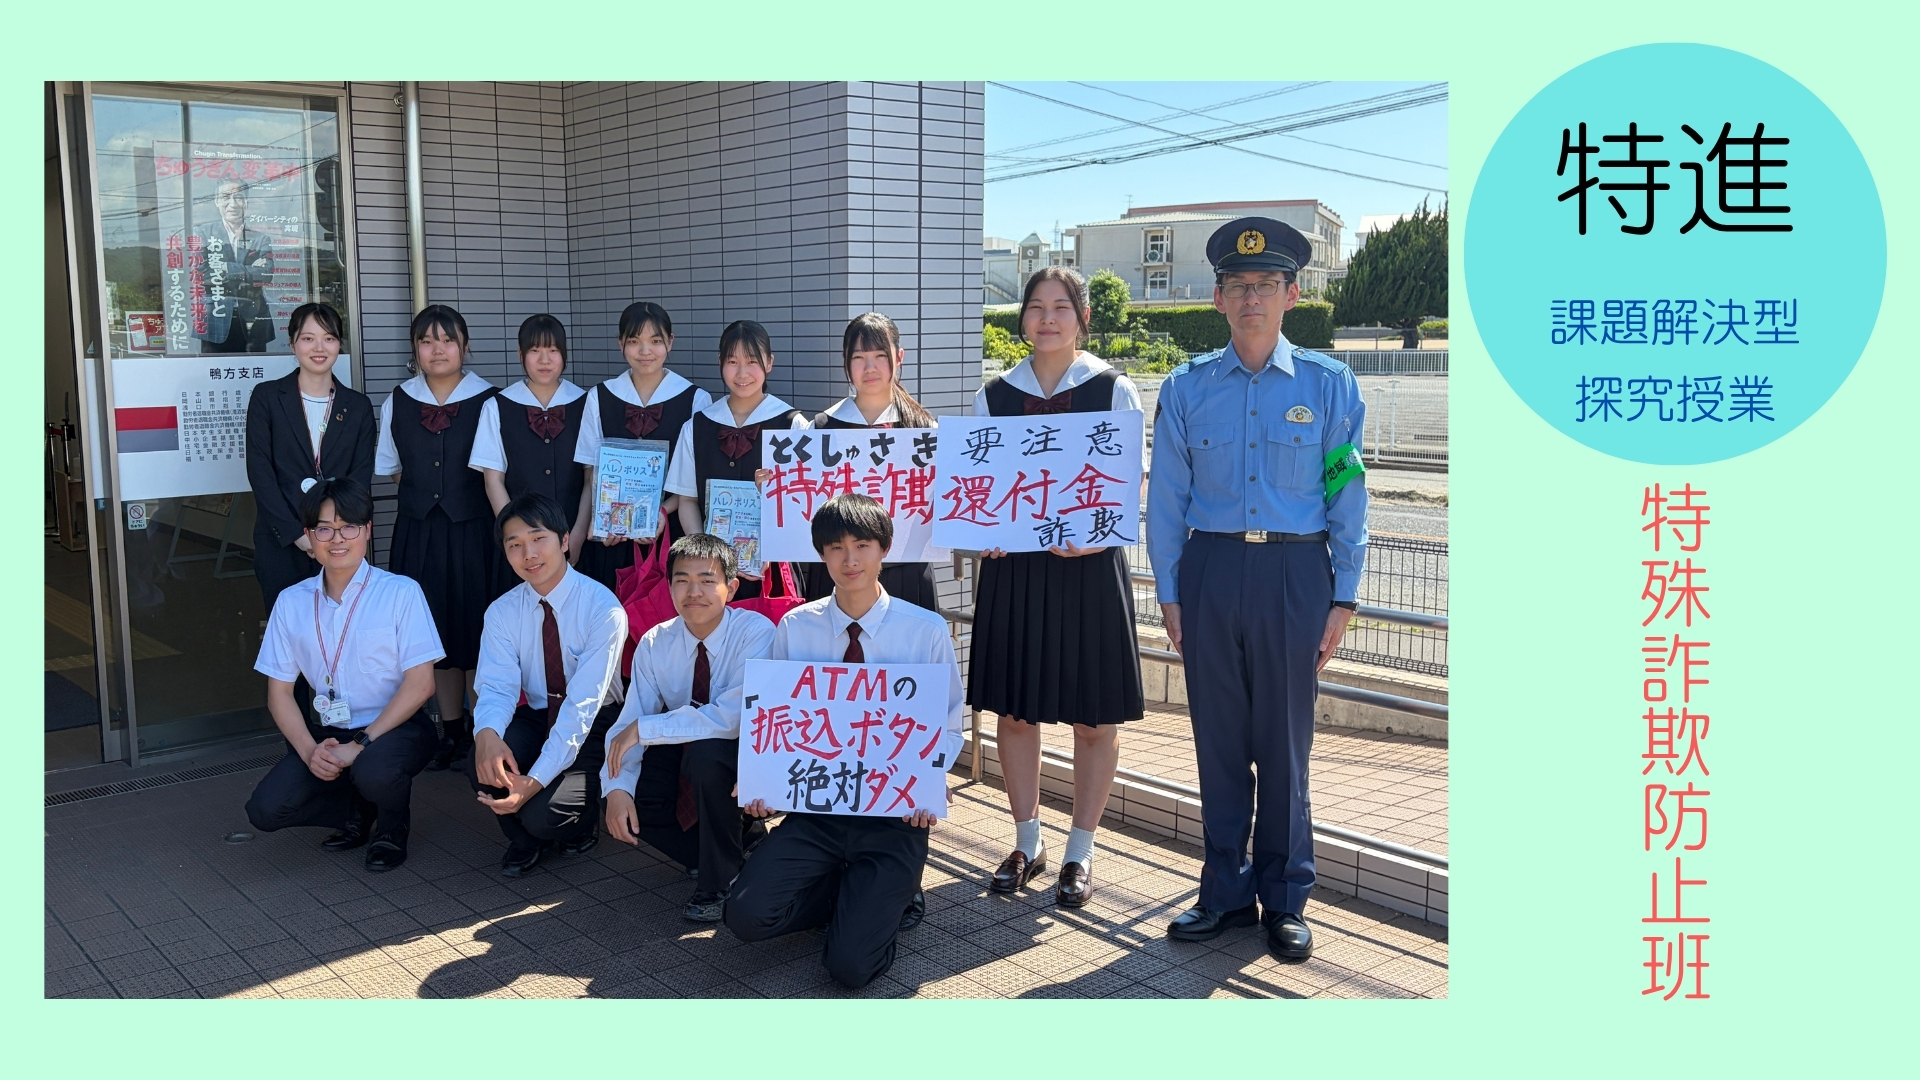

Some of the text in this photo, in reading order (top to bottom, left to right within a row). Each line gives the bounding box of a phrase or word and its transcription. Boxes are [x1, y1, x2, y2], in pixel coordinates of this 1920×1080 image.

[194, 150, 216, 158] Chugin
[165, 235, 190, 351] 共創するために
[186, 236, 207, 334] 豊かな未来を
[206, 236, 227, 318] お客さまと
[209, 367, 264, 380] 鴨方支店
[961, 421, 1123, 465] 要注意
[938, 463, 1130, 527] 還付金
[1032, 508, 1136, 548] 詐欺
[790, 665, 917, 702] ATMの
[786, 758, 917, 813] 絶対ダメ
